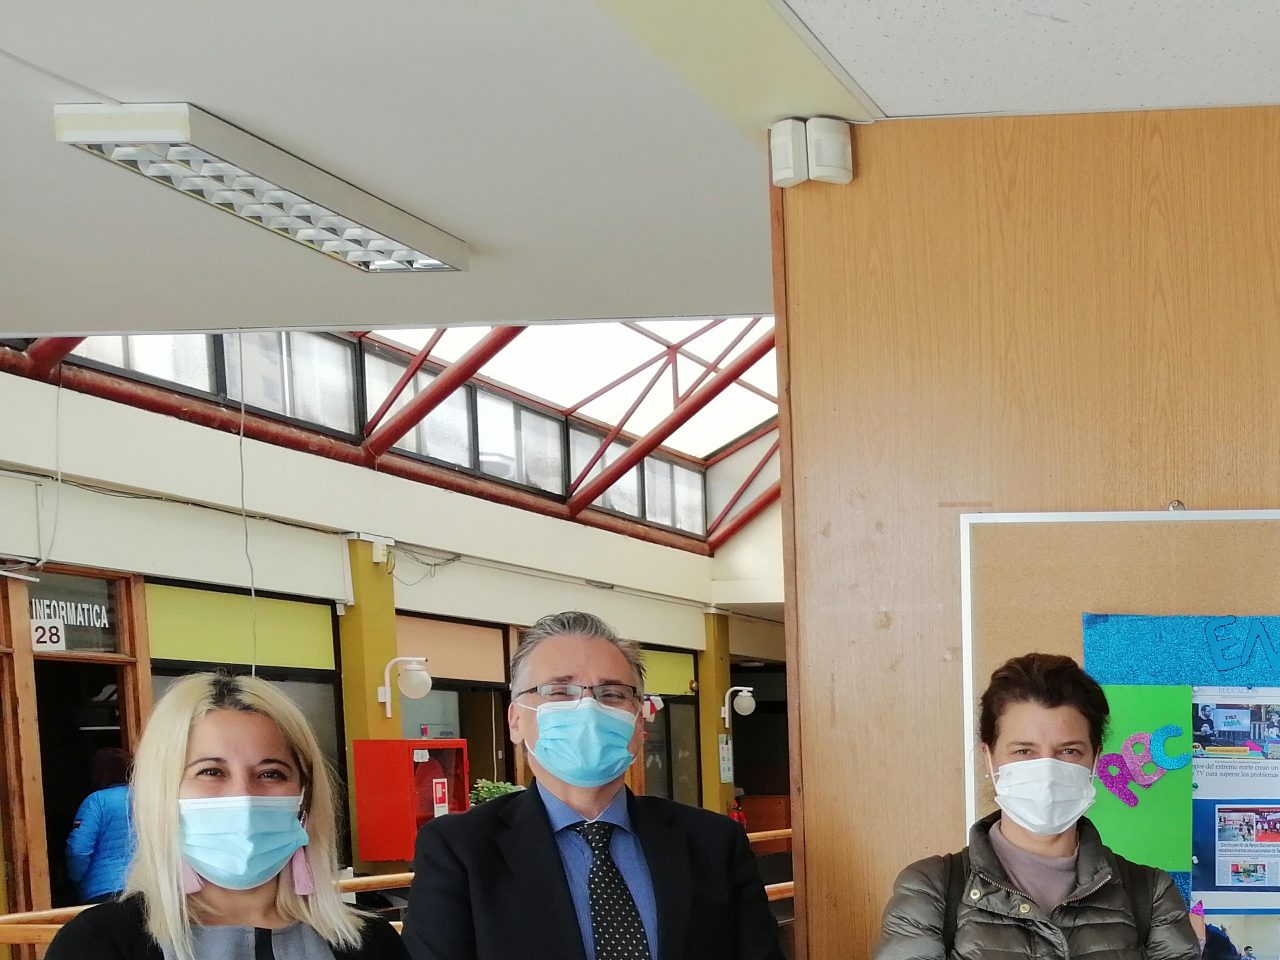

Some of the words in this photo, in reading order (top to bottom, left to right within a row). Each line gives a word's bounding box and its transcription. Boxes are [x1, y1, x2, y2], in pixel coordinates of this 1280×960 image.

[32, 598, 109, 628] INFORMATICA
[34, 625, 61, 645] 28
[1096, 724, 1192, 808] ABC
